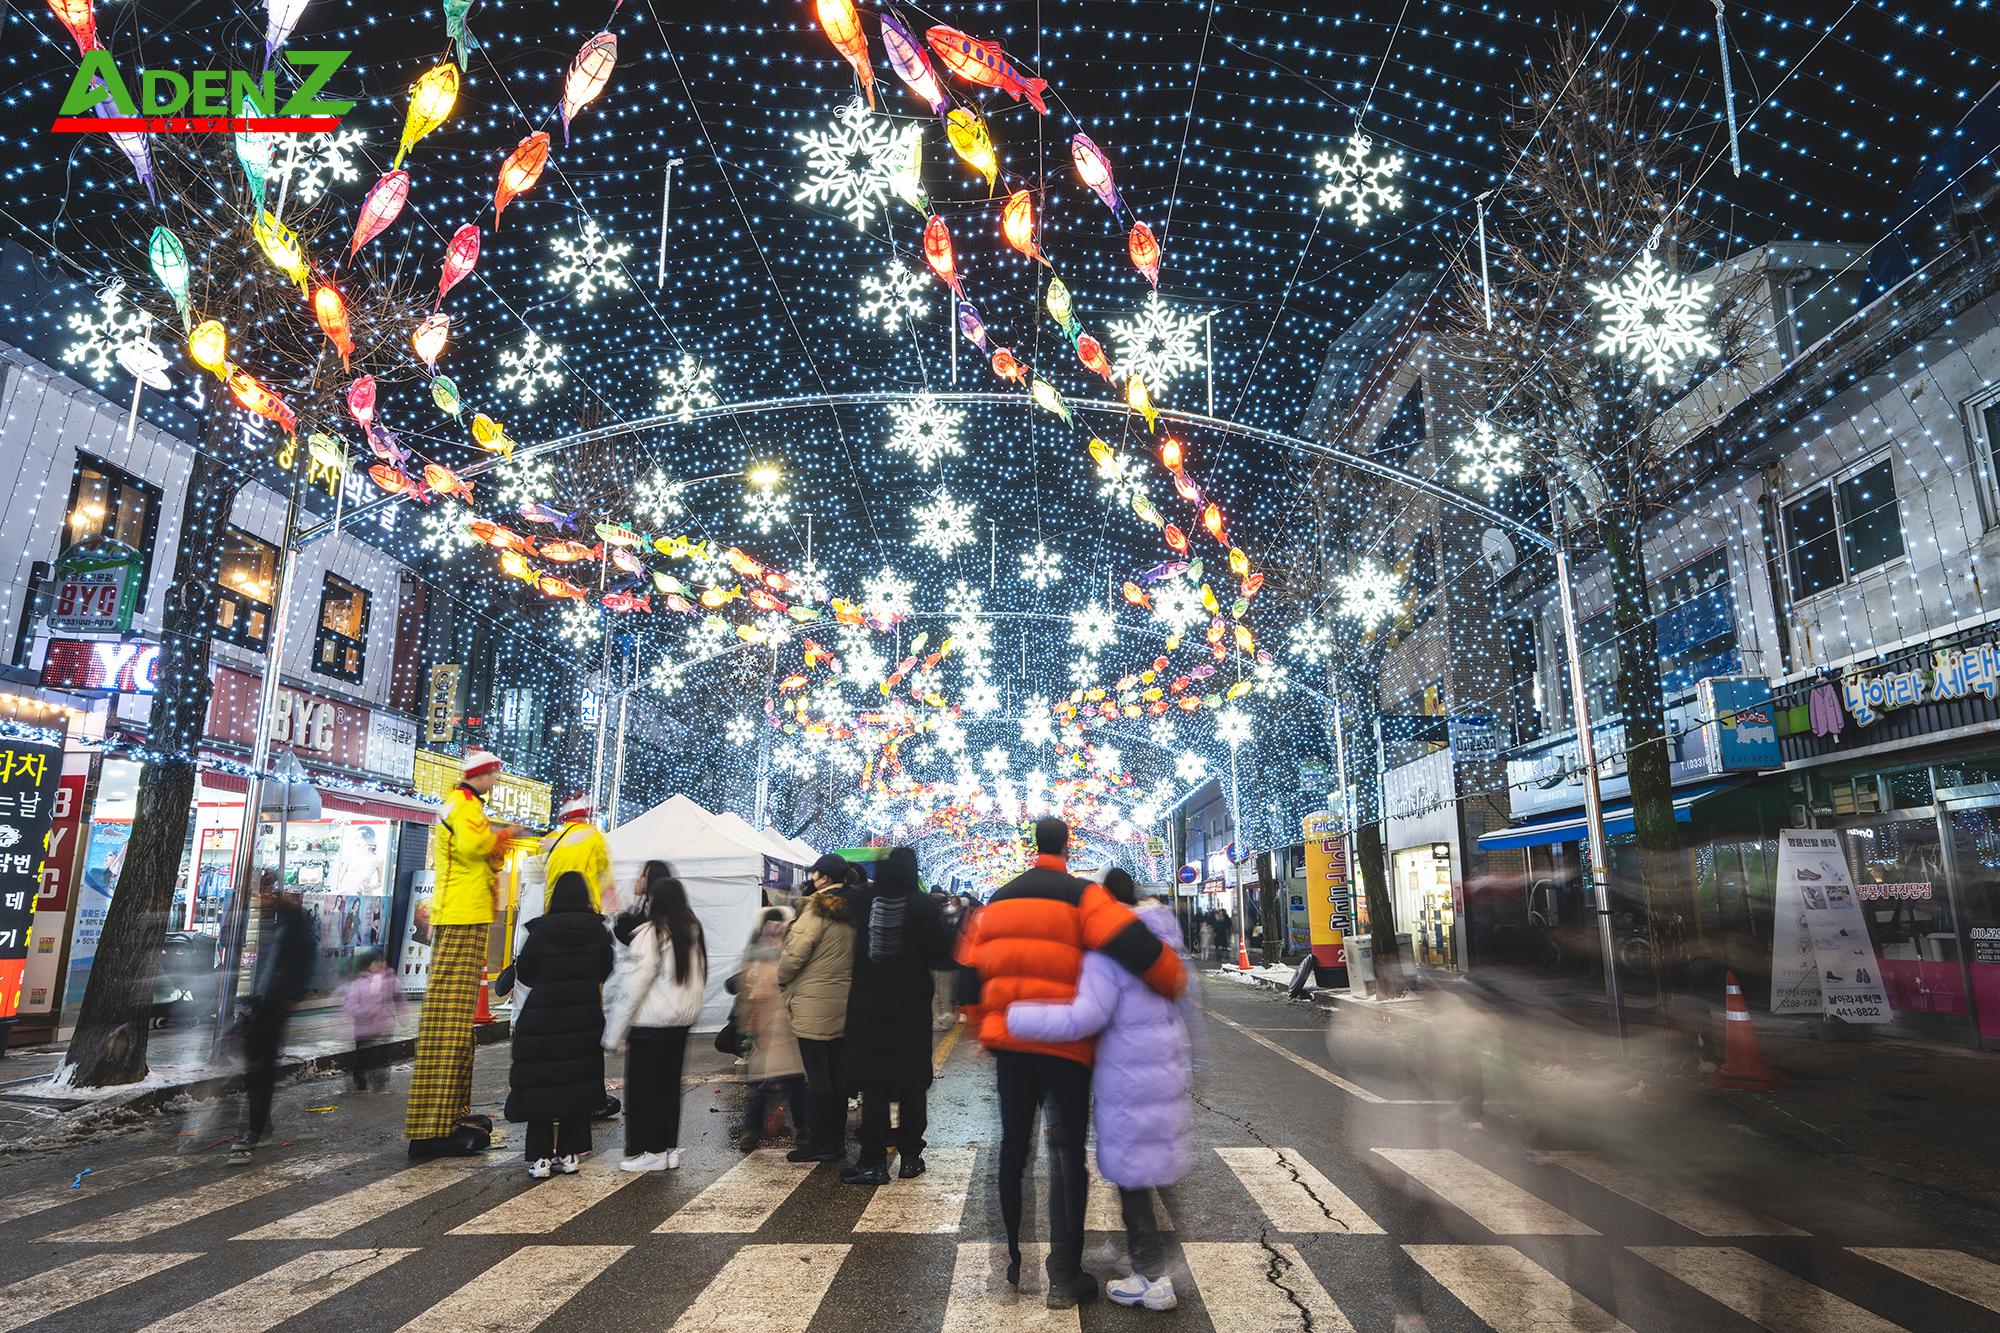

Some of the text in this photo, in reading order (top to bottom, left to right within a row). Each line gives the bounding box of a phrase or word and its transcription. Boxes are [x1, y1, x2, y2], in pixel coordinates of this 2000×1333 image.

[56, 584, 118, 617] BYC
[271, 689, 335, 751] BYC
[1845, 675, 1923, 724] 날아라
[1836, 1007, 1880, 1017] 441-8822
